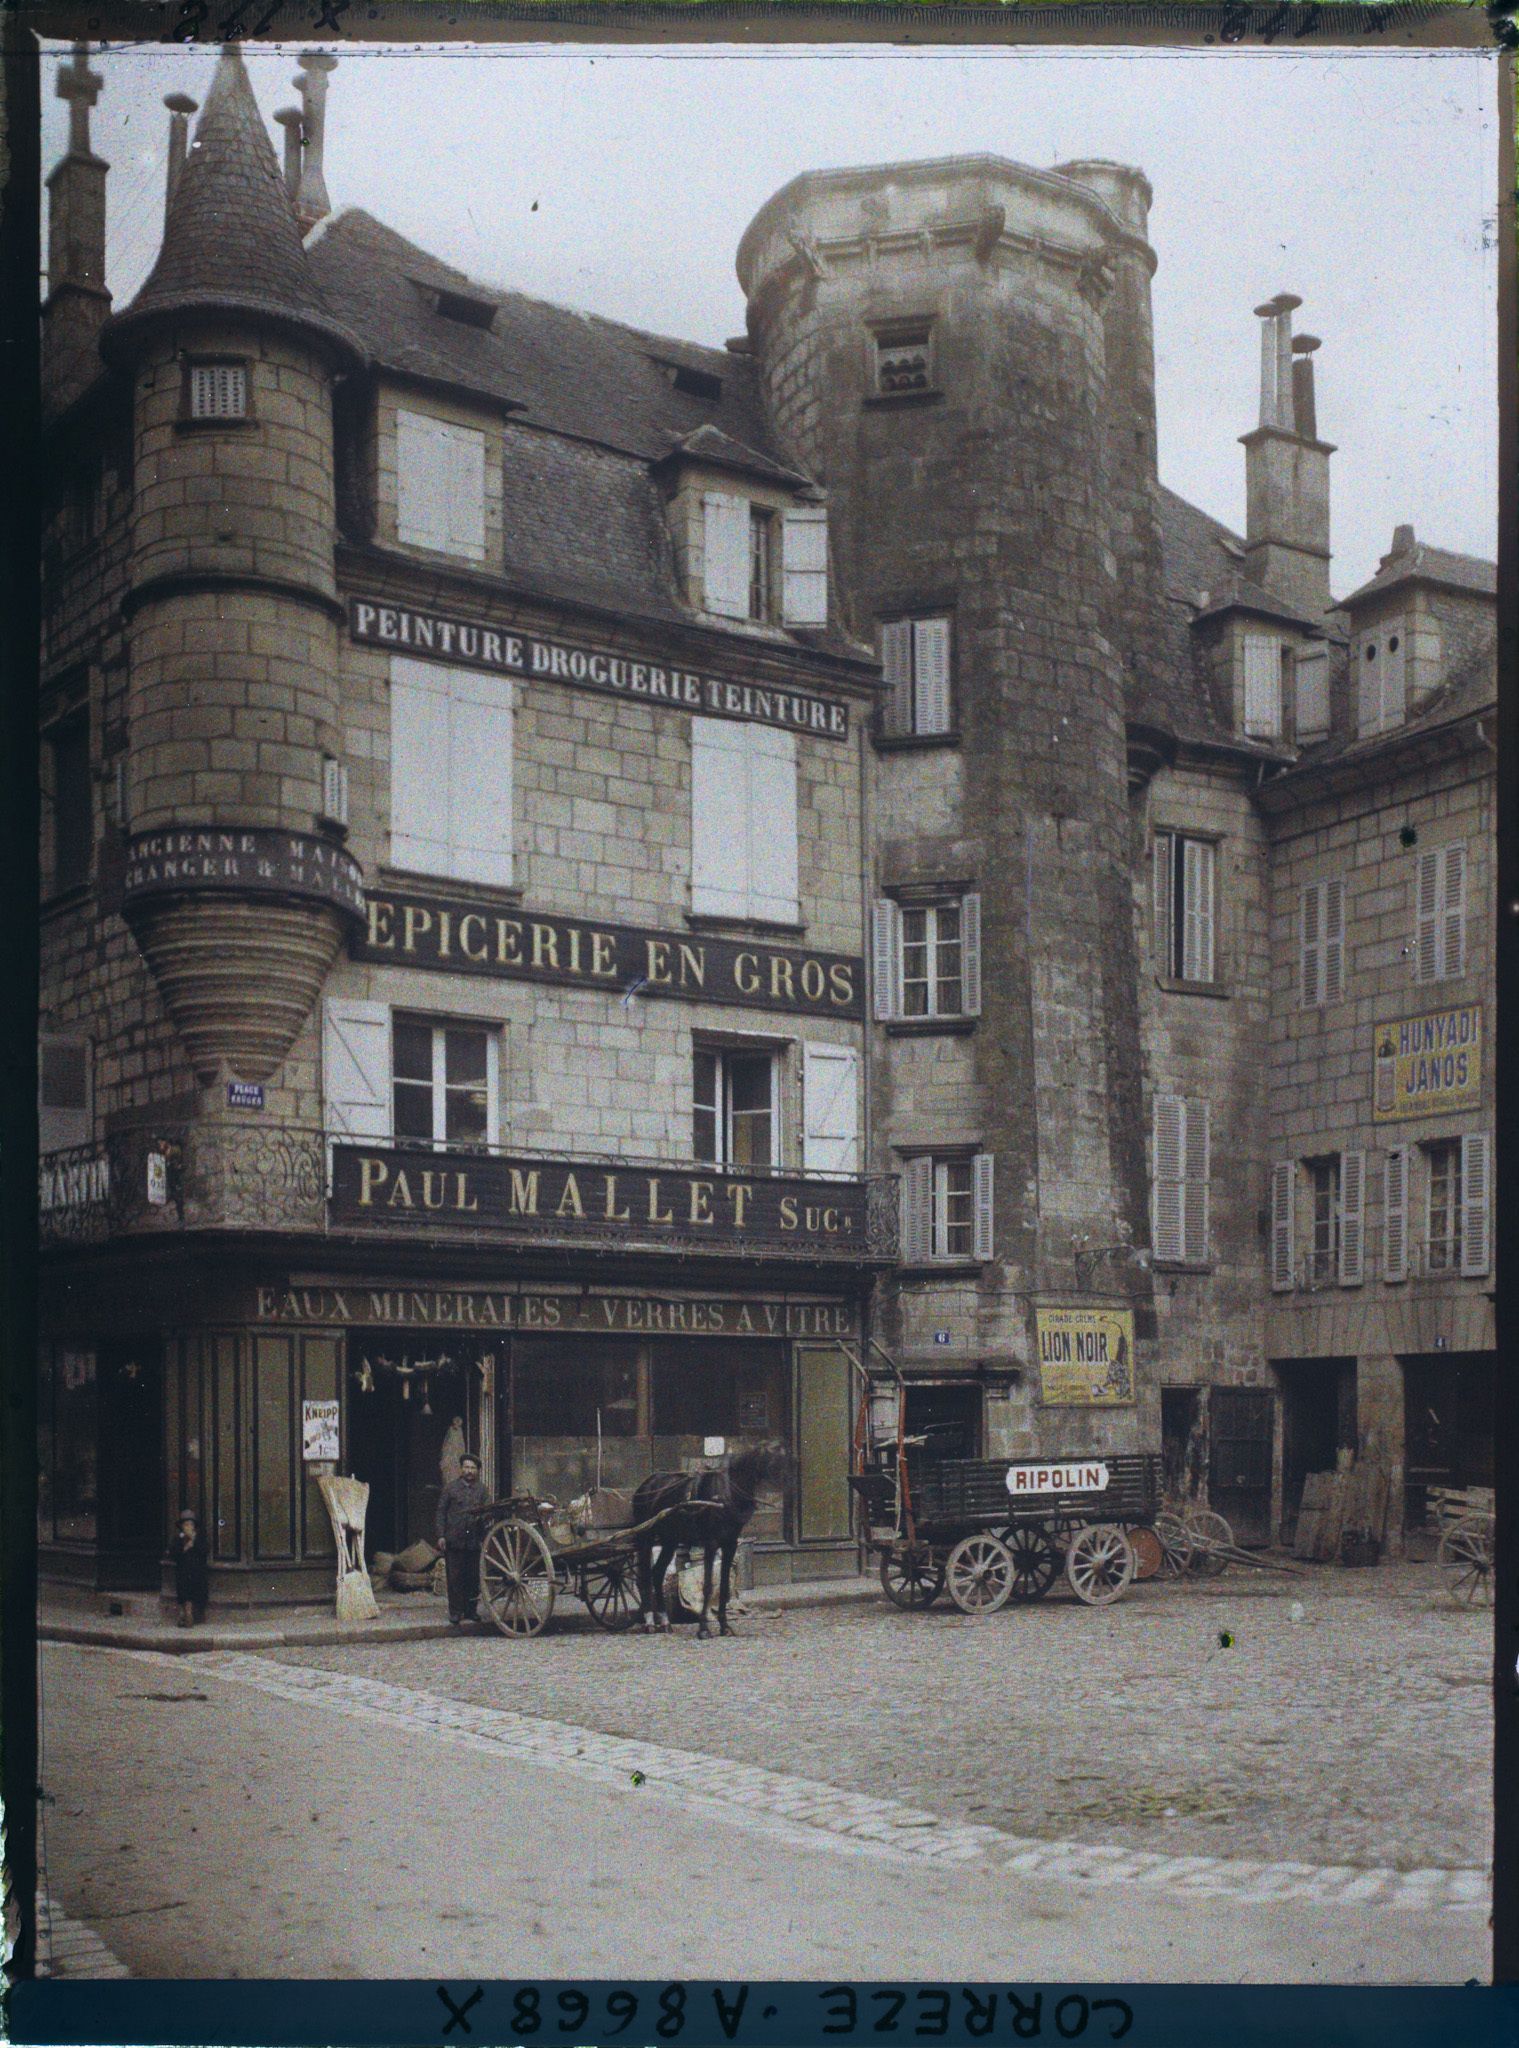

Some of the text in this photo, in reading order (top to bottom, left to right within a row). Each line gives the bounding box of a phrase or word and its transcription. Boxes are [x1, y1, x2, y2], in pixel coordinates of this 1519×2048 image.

[357, 602, 846, 734] PEINTURE DROGUERIE TEINTURE
[128, 834, 256, 862] ANCIENNE
[258, 857, 274, 878] &
[366, 901, 855, 1004] EPICERIE EN GROS
[1400, 1009, 1479, 1057] HUNYADI
[1405, 1052, 1468, 1095] JANOS
[358, 1157, 478, 1212] PAUL
[508, 1167, 753, 1228] MALLET
[256, 1286, 353, 1321] EAUX
[367, 1292, 561, 1327] MINERALES
[602, 1299, 725, 1331] VERRES
[735, 1303, 755, 1333] A
[764, 1305, 850, 1334] VITRE
[1042, 1331, 1109, 1362] LION NOIR
[305, 1406, 338, 1421] KNEIPP
[1016, 1467, 1100, 1489] RIPOLIN
